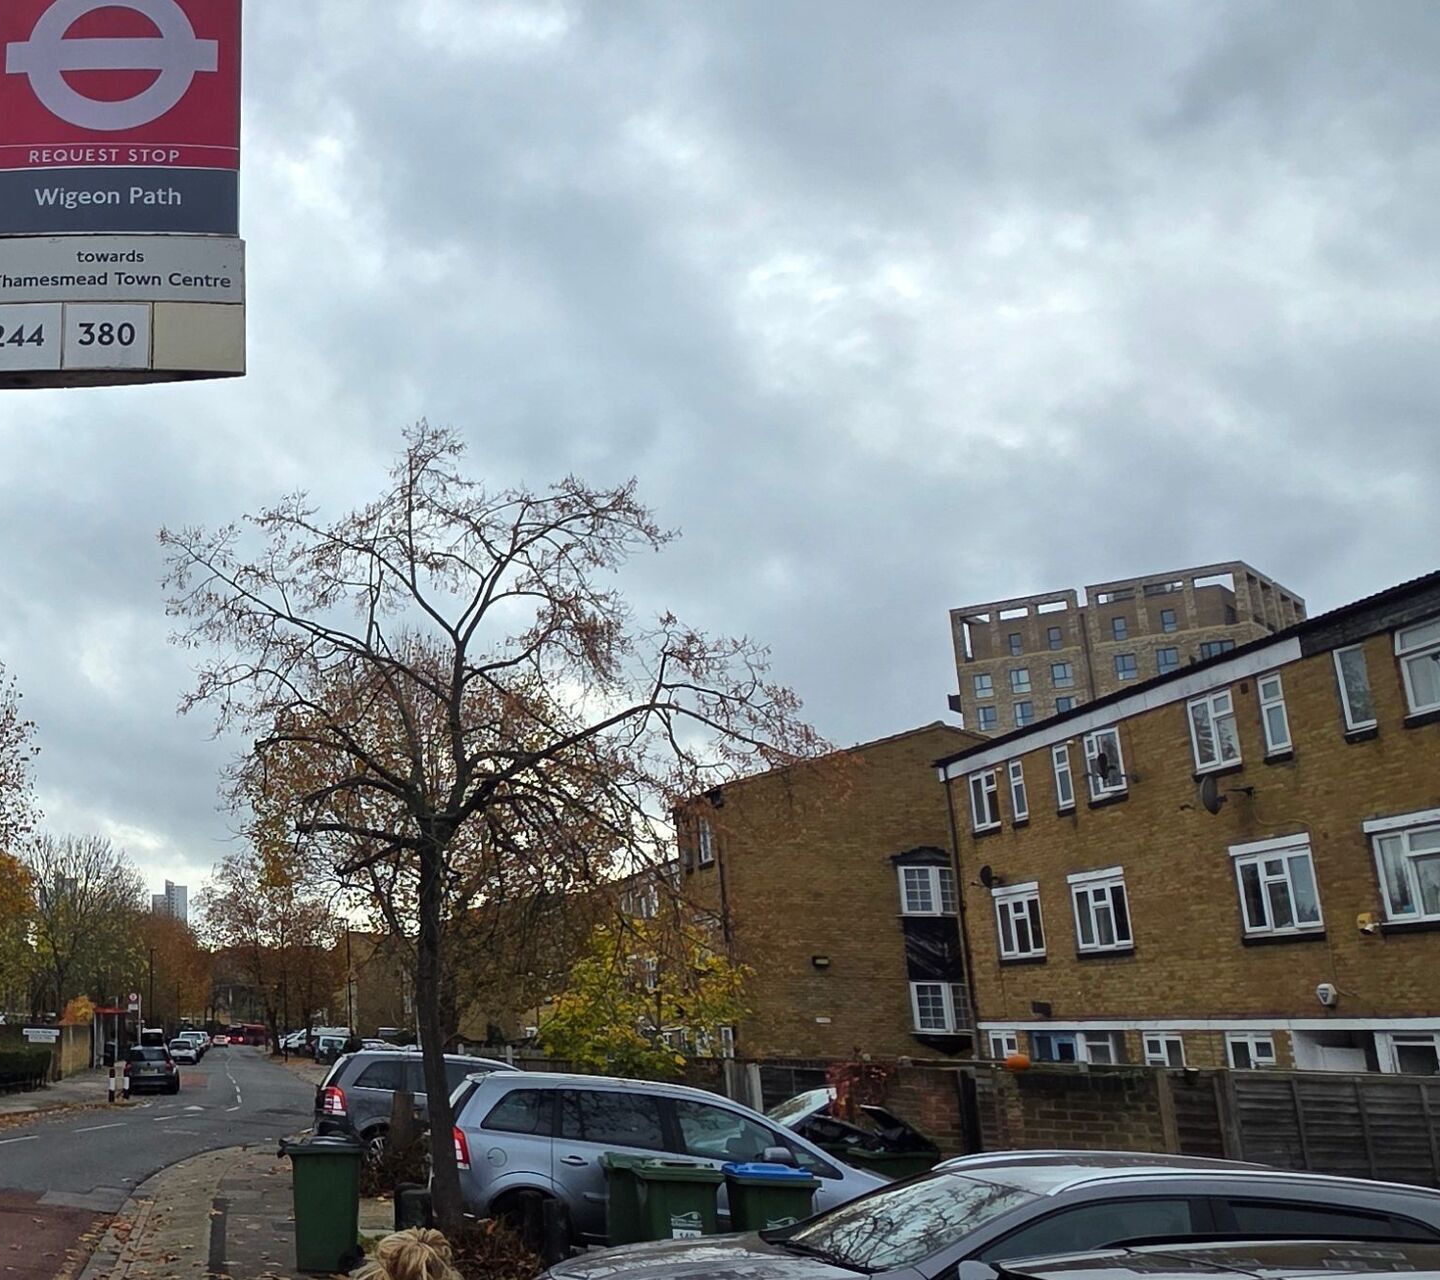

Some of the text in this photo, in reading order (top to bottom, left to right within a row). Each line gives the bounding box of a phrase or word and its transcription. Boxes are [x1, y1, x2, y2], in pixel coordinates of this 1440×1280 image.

[28, 148, 180, 163] REQUEST STOP
[34, 186, 182, 209] Wigeon Path
[76, 250, 144, 263] towards
[114, 272, 162, 286] Town
[168, 272, 231, 288] Centre
[78, 322, 136, 346] 380
